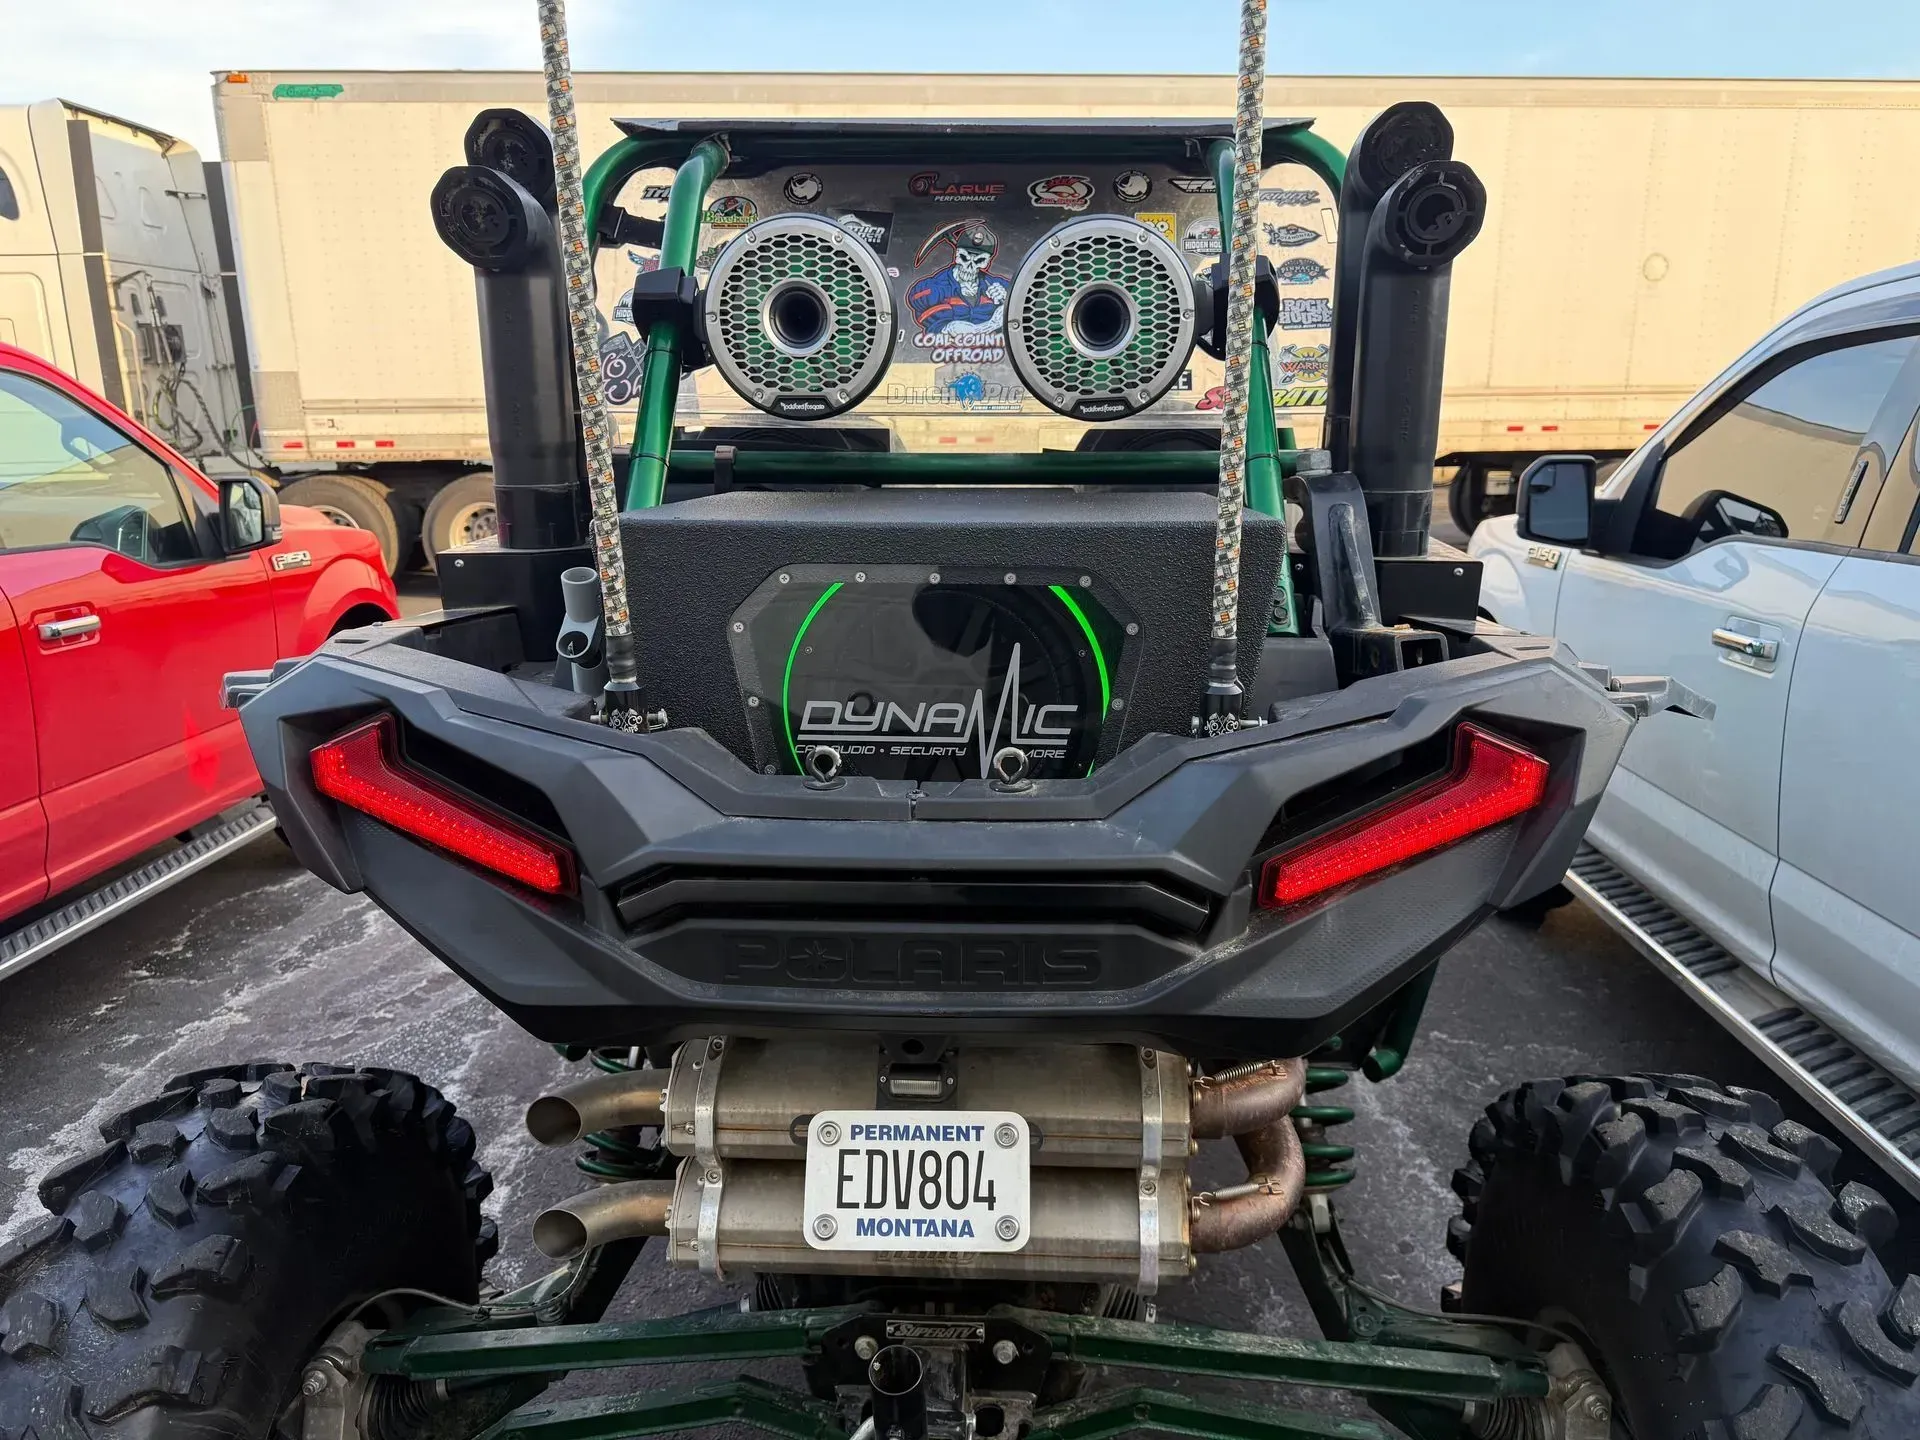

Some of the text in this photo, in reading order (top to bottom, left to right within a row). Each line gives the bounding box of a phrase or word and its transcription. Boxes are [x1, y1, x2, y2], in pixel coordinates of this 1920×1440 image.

[1283, 299, 1329, 312] ROCK
[1278, 311, 1333, 325] HOUSE
[913, 332, 953, 348] COAL
[931, 347, 1005, 363] OFFROAD
[889, 745, 967, 756] SECURITY
[722, 933, 1102, 985] POLARIS
[850, 1124, 985, 1142] PERMANENT
[836, 1148, 997, 1211] EDV804
[855, 1217, 975, 1238] MONTANA
